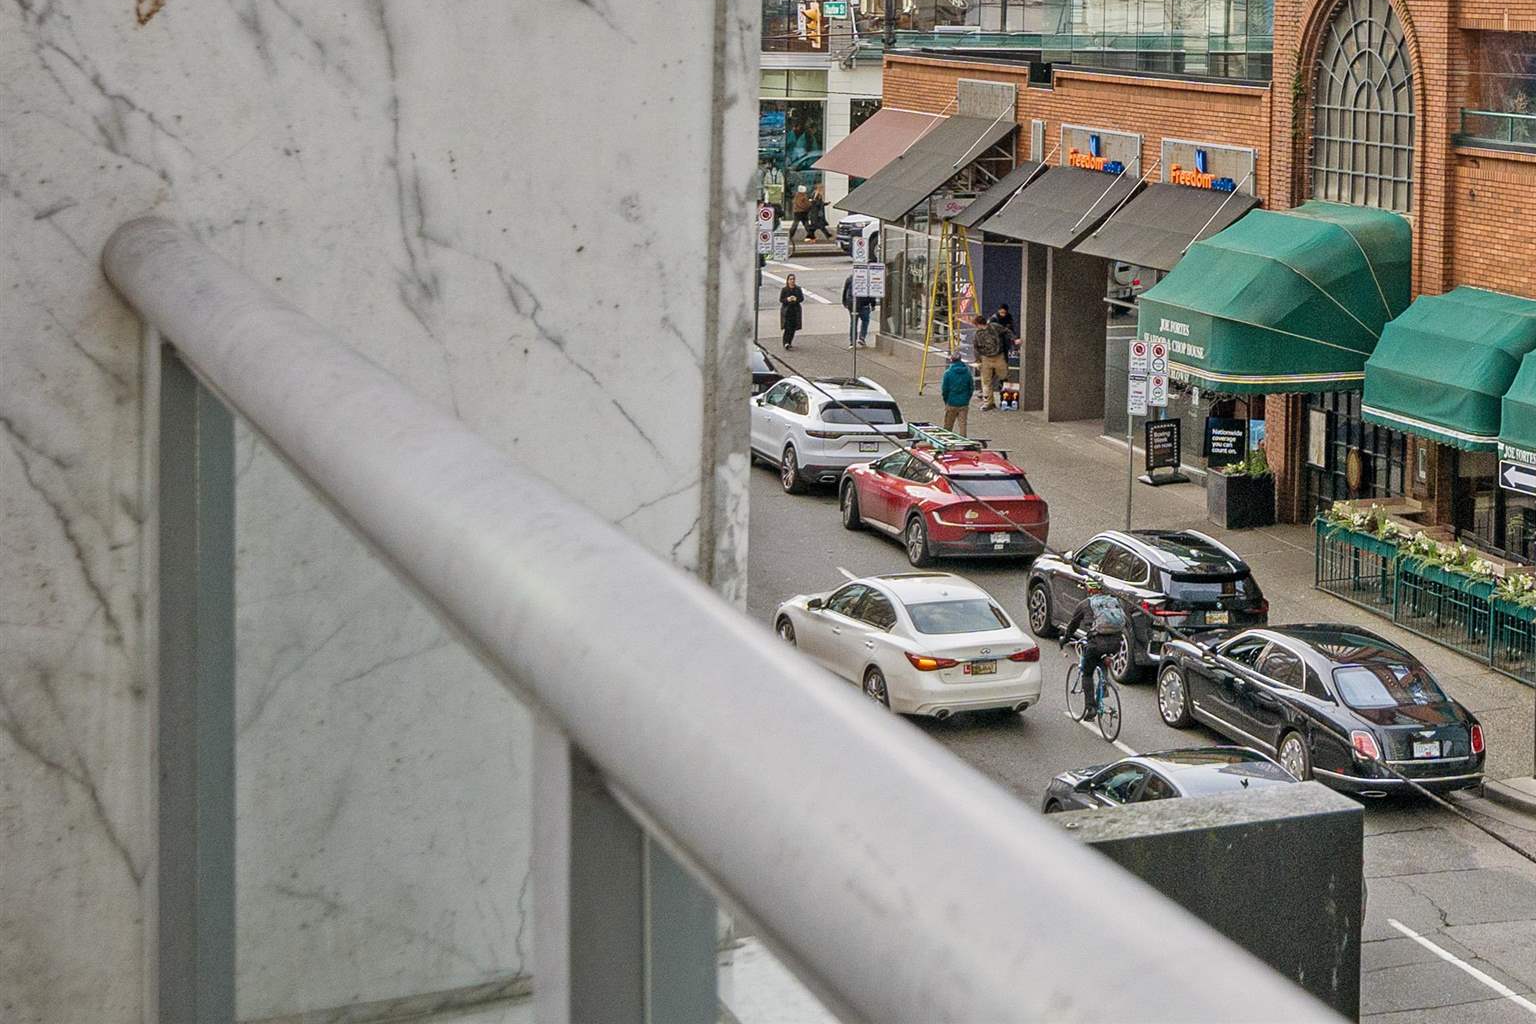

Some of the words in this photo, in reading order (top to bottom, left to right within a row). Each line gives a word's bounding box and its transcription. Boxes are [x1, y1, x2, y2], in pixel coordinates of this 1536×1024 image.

[1069, 148, 1108, 172] Freedom
[1171, 163, 1215, 190] Freedom
[1211, 429, 1243, 437] Nationwide
[1503, 445, 1516, 459] JOE
[1515, 448, 1536, 465] FORTES
